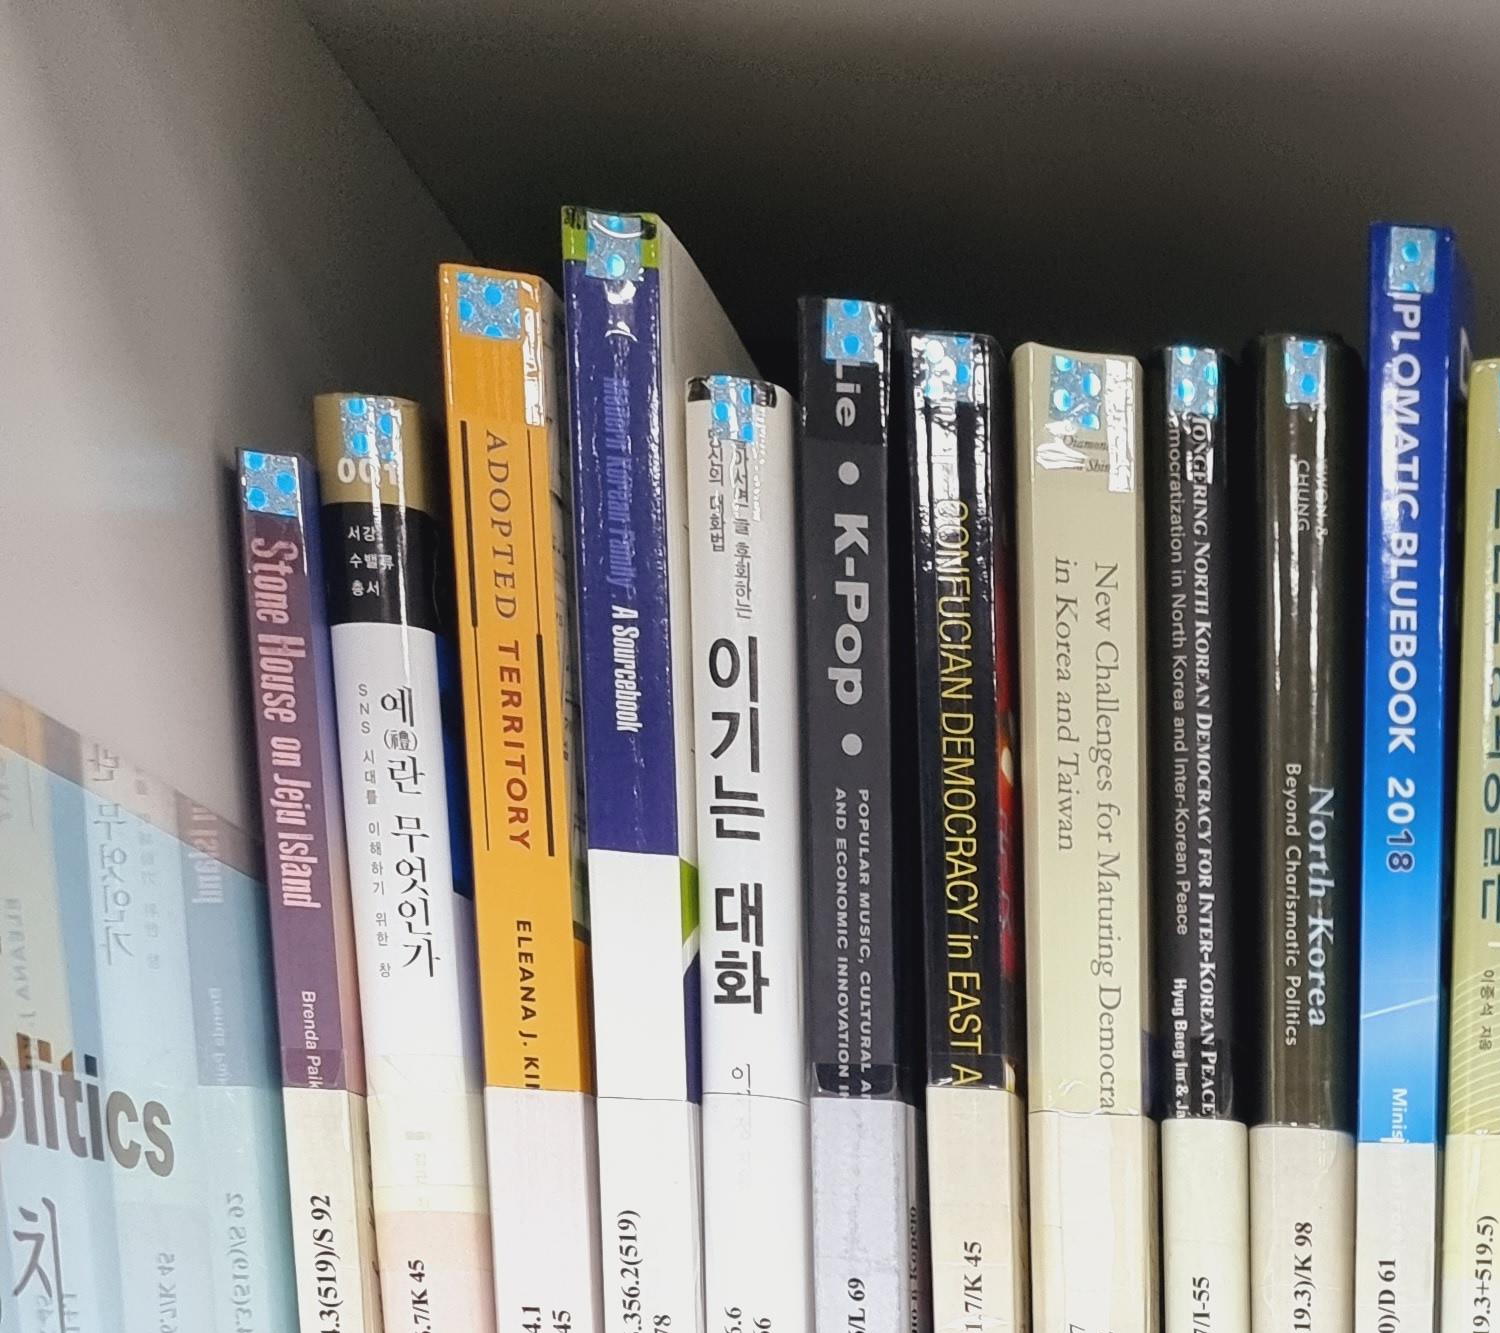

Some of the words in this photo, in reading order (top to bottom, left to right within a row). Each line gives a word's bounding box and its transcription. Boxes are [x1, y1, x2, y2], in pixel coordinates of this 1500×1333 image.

[485, 431, 517, 620] ADOPTED
[251, 537, 298, 625] Stone
[828, 513, 870, 705] K-Pop
[1172, 593, 1187, 648] North
[257, 633, 306, 723] House
[1055, 594, 1077, 683] Korea
[1195, 620, 1212, 707] KOREAN
[1388, 532, 1421, 754] BLUEBOOK
[498, 639, 531, 850] TERRITORY
[708, 635, 765, 841] 이기는
[1057, 695, 1077, 741] and
[1089, 641, 1119, 792] Challenges
[834, 788, 847, 831] AND
[941, 712, 979, 924] DEMOCRACY
[1056, 751, 1080, 851] Taiwan
[1175, 758, 1190, 876] Inter-Korean
[1196, 713, 1213, 853] DEMOCRACY
[1283, 764, 1301, 835] Beyond
[1386, 777, 1416, 873] 2018
[858, 788, 871, 886] POPULAR
[1308, 785, 1335, 898] North
[390, 814, 441, 978] 무엇인가
[835, 837, 848, 949] ECONOMIC
[858, 892, 873, 964] MUSIC,
[1091, 851, 1121, 979] Maturing
[1285, 845, 1301, 967] Charismatic
[516, 919, 538, 1022] ELEANA
[714, 882, 769, 1015] 대화
[1197, 893, 1217, 1047] INTER-KOREAN
[1308, 916, 1335, 1027] Korea
[301, 991, 319, 1049] Brenda
[837, 957, 849, 1077] INNOVATION
[859, 971, 873, 1074] CULTURAL
[1285, 975, 1301, 1046] Politics
[407, 1258, 425, 1283] 45
[1295, 1221, 1313, 1248] 98
[1378, 1259, 1397, 1282] 61
[848, 1277, 865, 1302] 69
